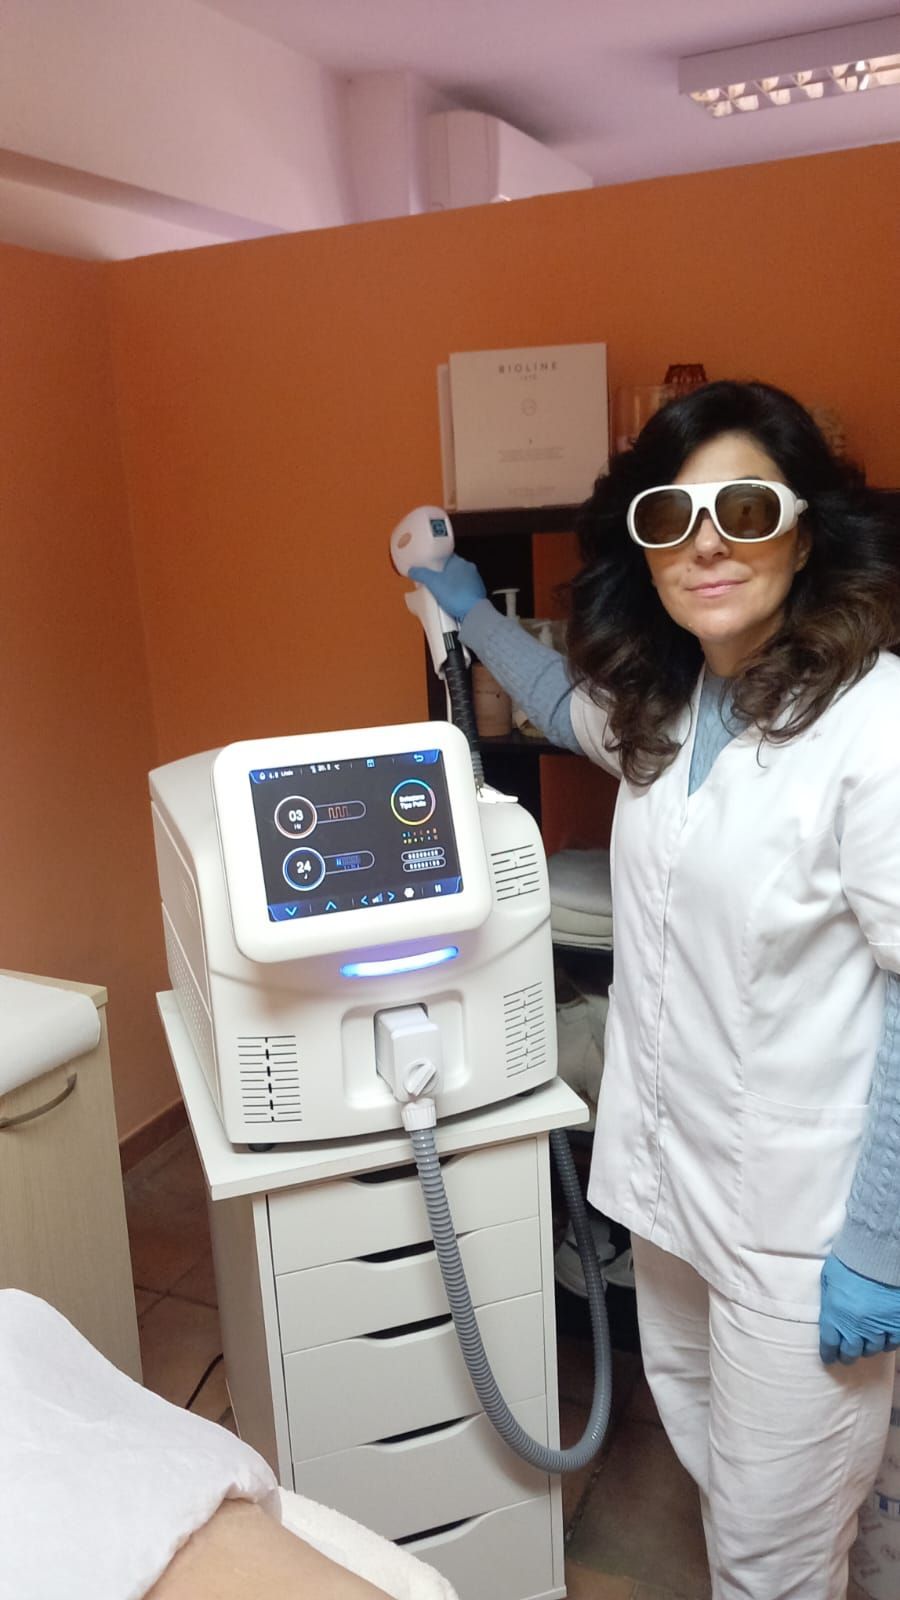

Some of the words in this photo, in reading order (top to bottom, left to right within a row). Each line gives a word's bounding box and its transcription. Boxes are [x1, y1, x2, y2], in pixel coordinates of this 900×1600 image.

[498, 361, 558, 374] BIOLINE
[288, 809, 304, 822] 03
[296, 860, 312, 874] 24
